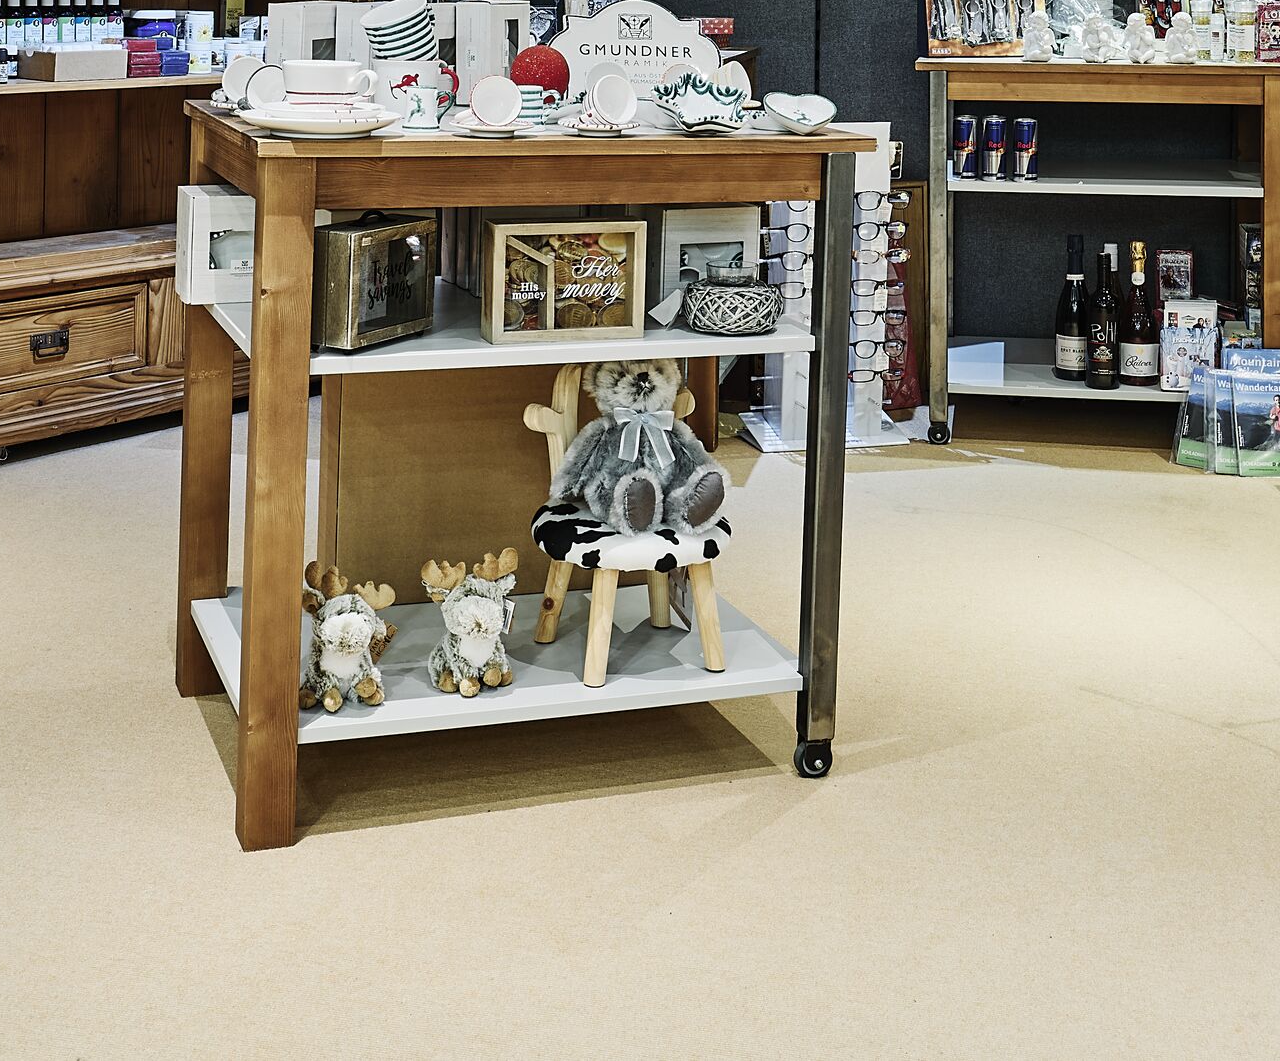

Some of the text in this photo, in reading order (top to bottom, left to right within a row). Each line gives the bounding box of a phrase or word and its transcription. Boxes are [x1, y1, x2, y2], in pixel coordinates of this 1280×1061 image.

[579, 44, 692, 58] GMUNDNER
[372, 251, 413, 285] Travel
[572, 255, 622, 278] Her
[368, 279, 413, 309] savings
[512, 290, 546, 300] money
[520, 282, 539, 292] His
[562, 281, 626, 305] money
